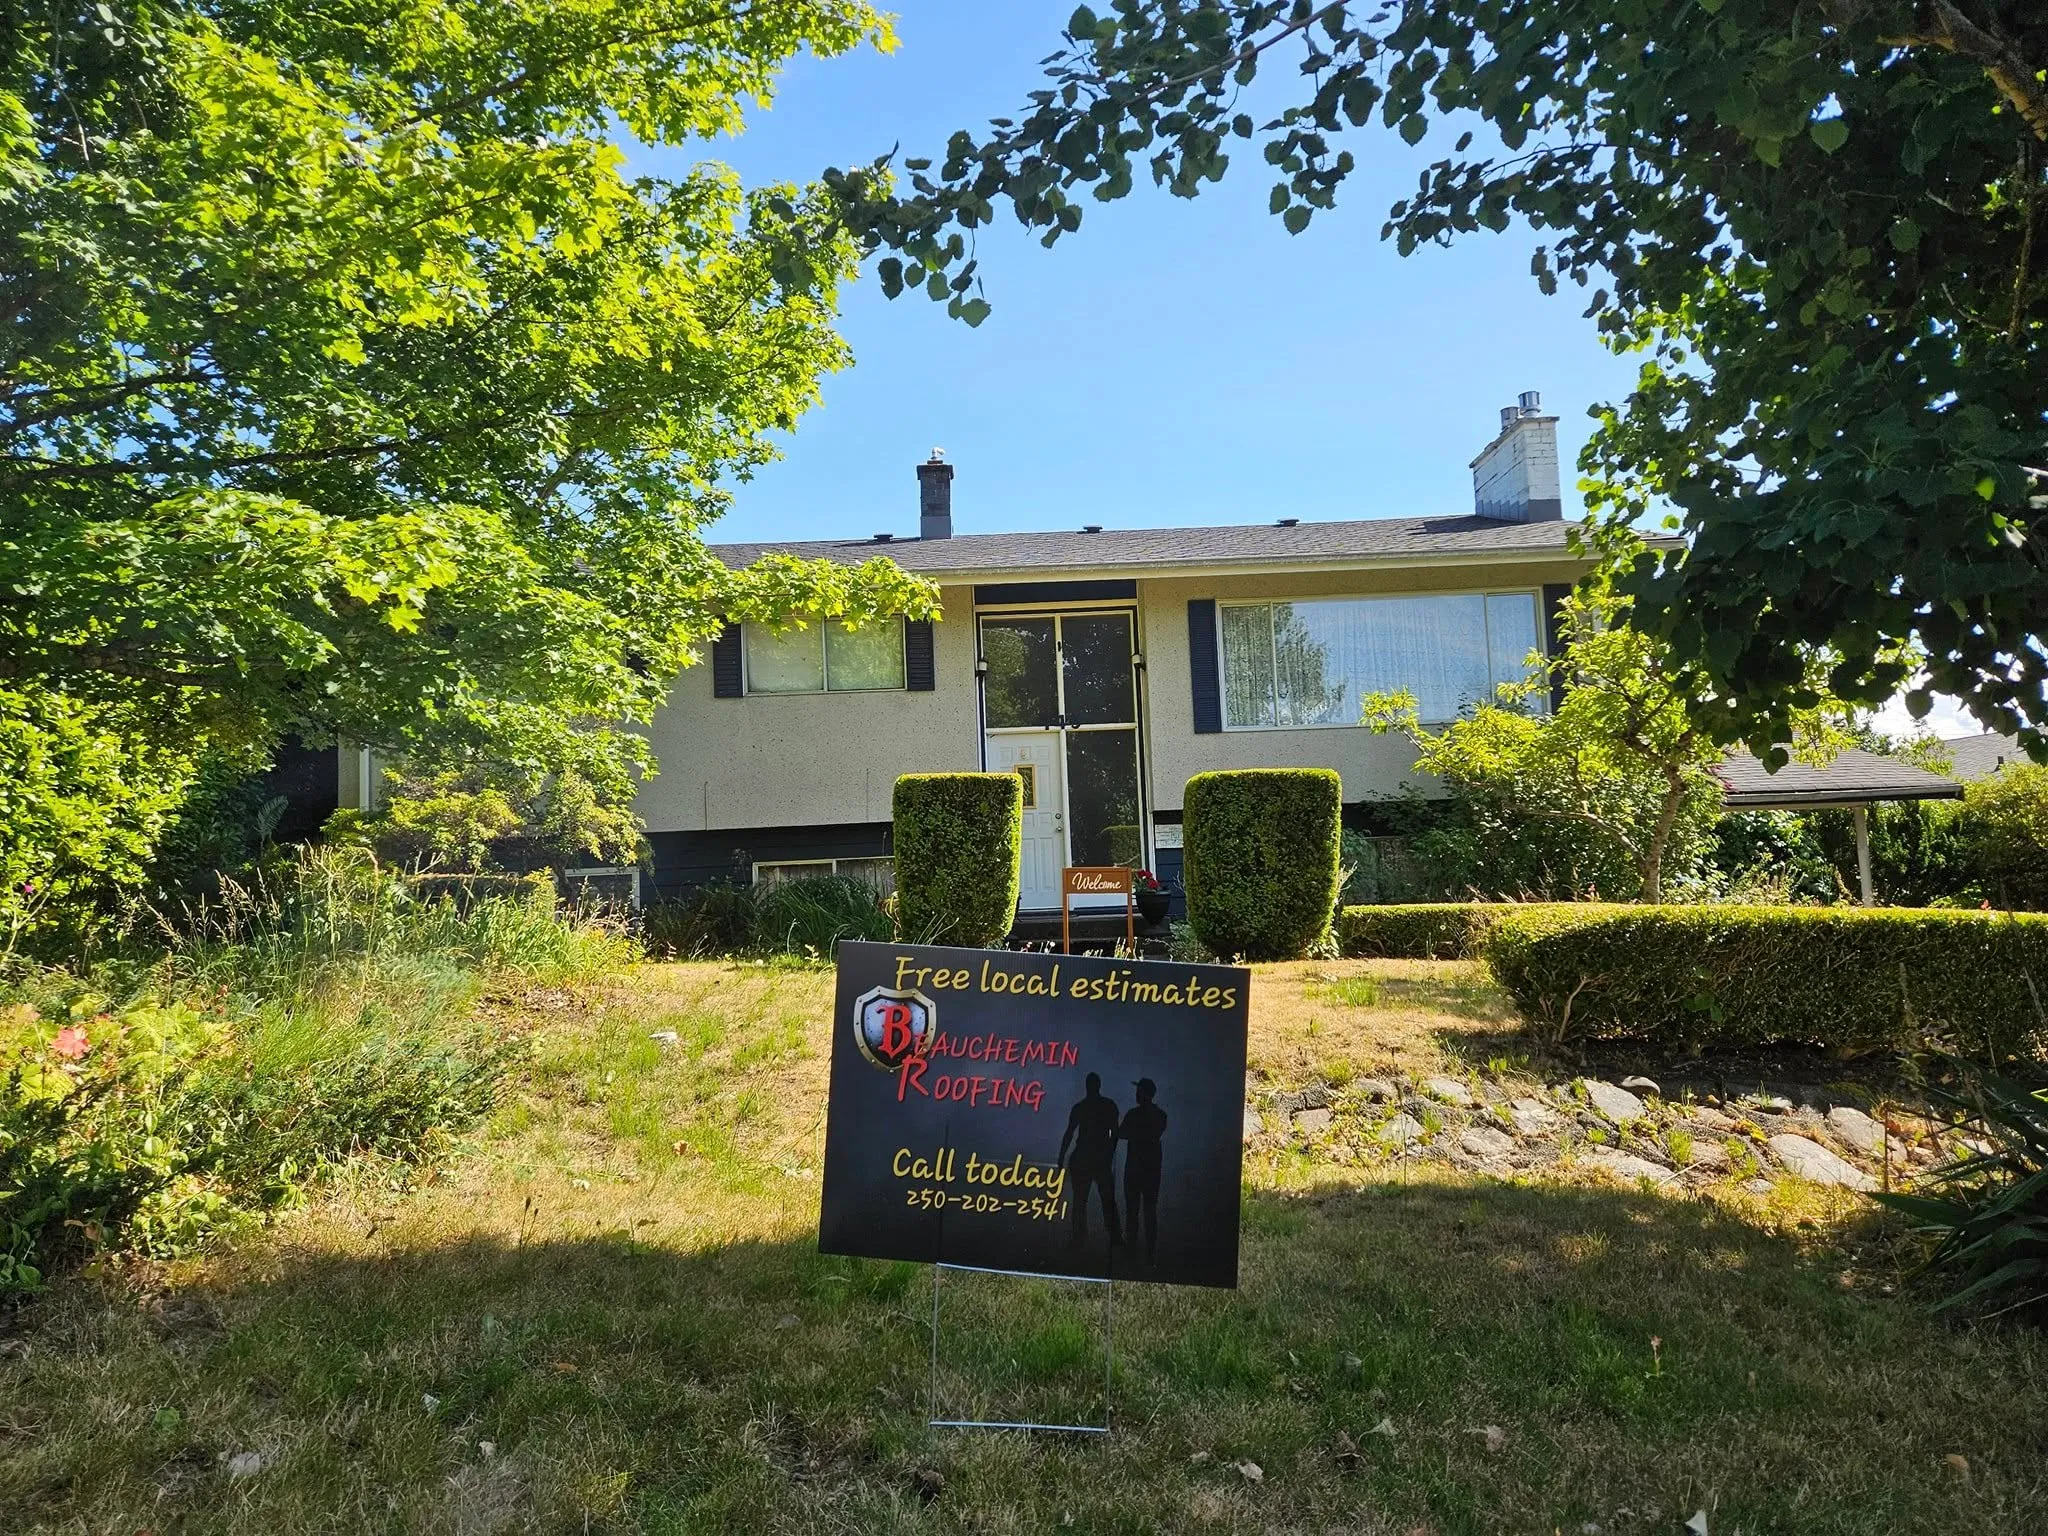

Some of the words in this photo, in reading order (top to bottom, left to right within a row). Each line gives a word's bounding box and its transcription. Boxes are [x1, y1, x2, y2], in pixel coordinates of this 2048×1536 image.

[1071, 872, 1122, 890] Welcome
[896, 956, 970, 990] Free
[980, 960, 1060, 997] local
[1069, 970, 1237, 1010] estimates
[876, 1004, 1078, 1068] BEAUCHEMIN
[898, 1054, 1046, 1112] ROOFING
[893, 1147, 956, 1183] Call
[965, 1152, 1066, 1199] today
[906, 1187, 1068, 1221] 250-202-2541
